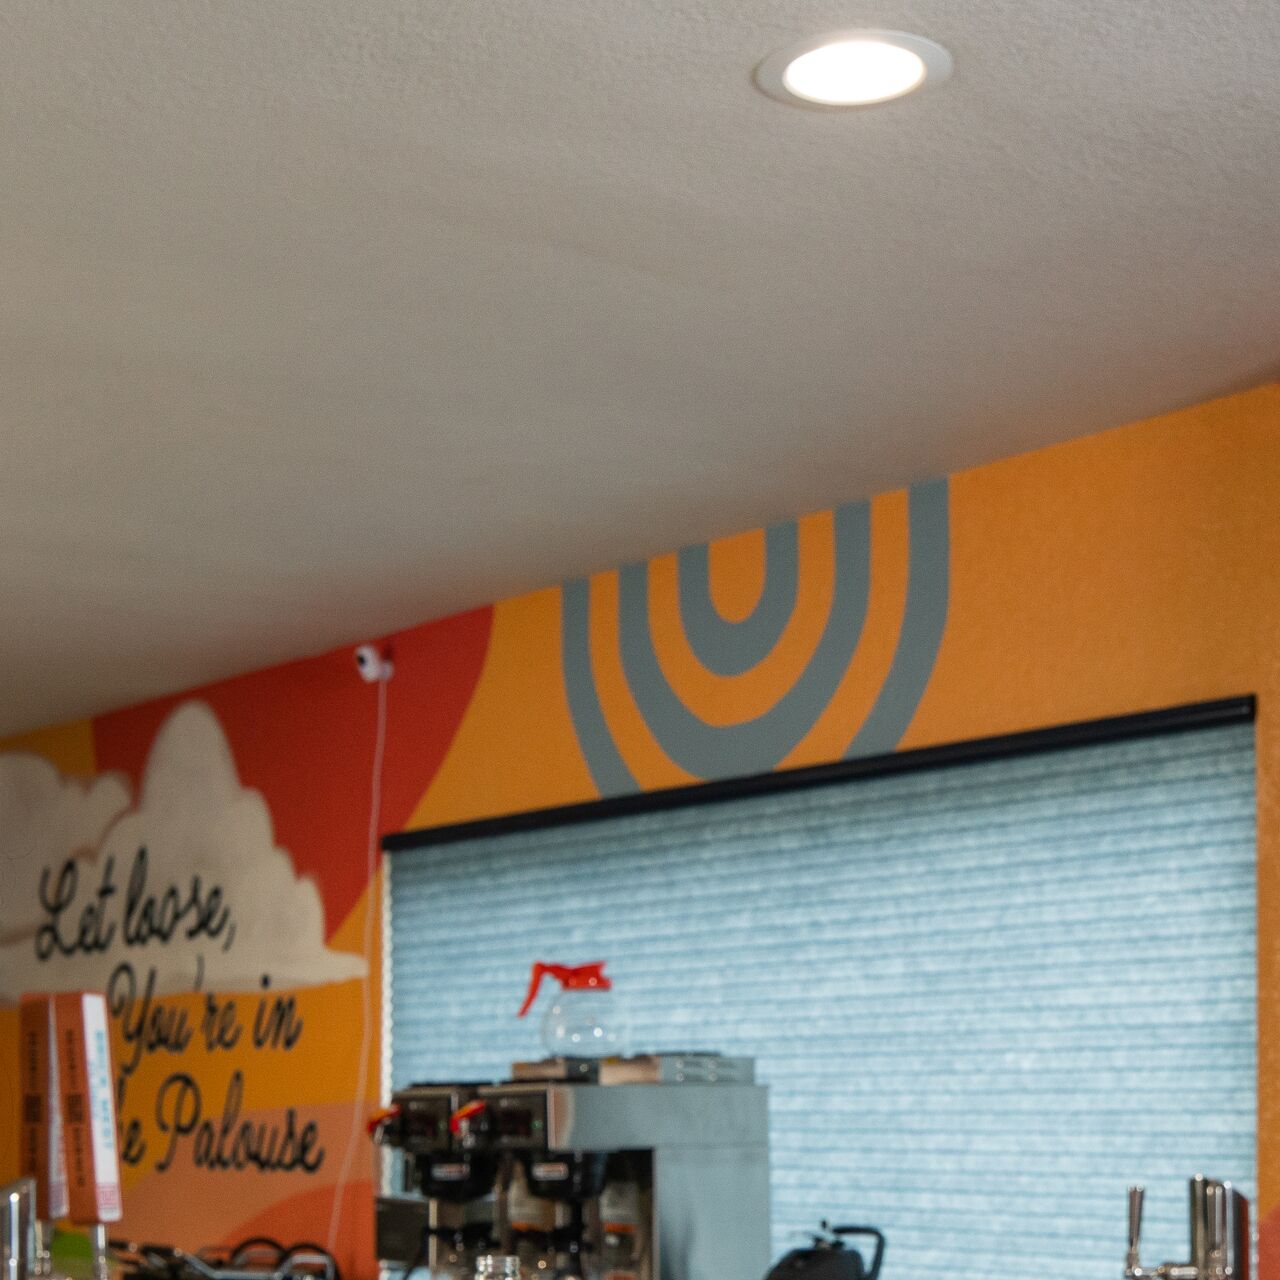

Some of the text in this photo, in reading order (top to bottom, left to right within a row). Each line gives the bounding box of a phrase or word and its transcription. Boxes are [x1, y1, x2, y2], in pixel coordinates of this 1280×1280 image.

[34, 845, 235, 960] Let loose,
[107, 954, 304, 1075] You're in
[155, 1070, 324, 1173] Palouse
